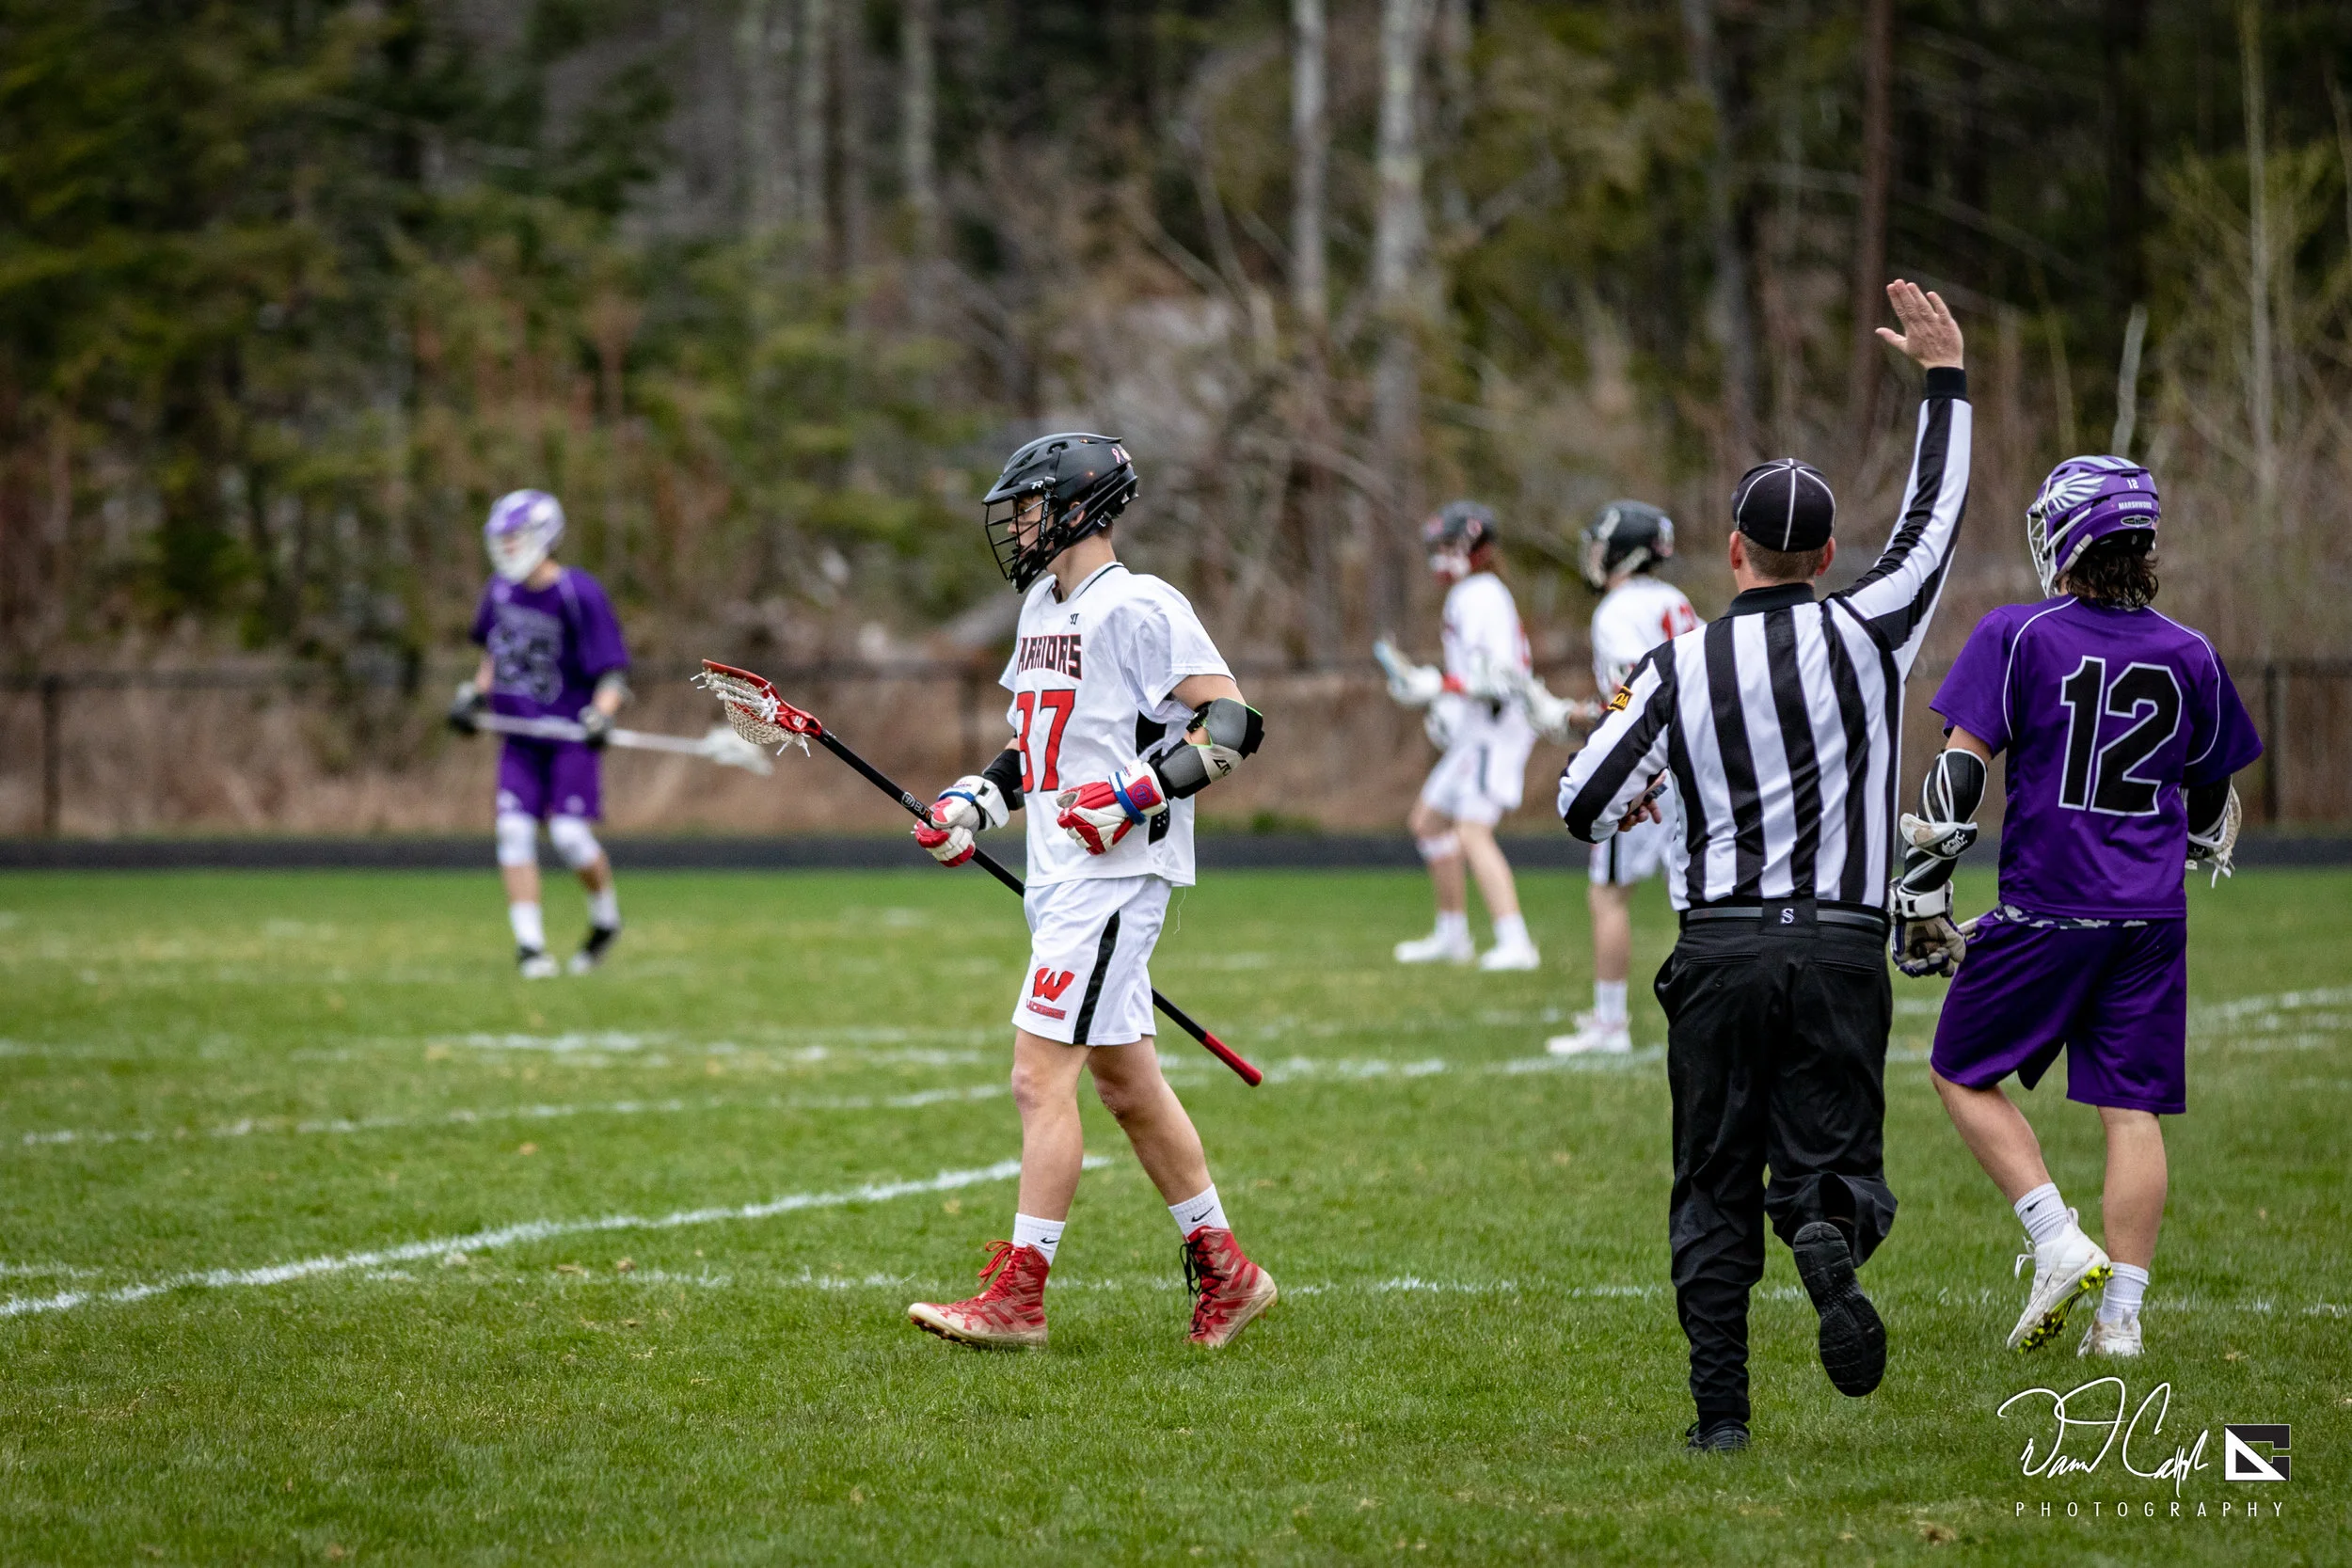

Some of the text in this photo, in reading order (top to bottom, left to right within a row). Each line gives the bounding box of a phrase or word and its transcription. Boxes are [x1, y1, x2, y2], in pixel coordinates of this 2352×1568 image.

[2127, 479, 2139, 489] 12
[2119, 501, 2153, 510] MARSHWOOD
[1017, 633, 1082, 680] ARRIORS
[2058, 655, 2183, 816] 12
[1780, 908, 1795, 924] S
[1032, 967, 1075, 1002] W
